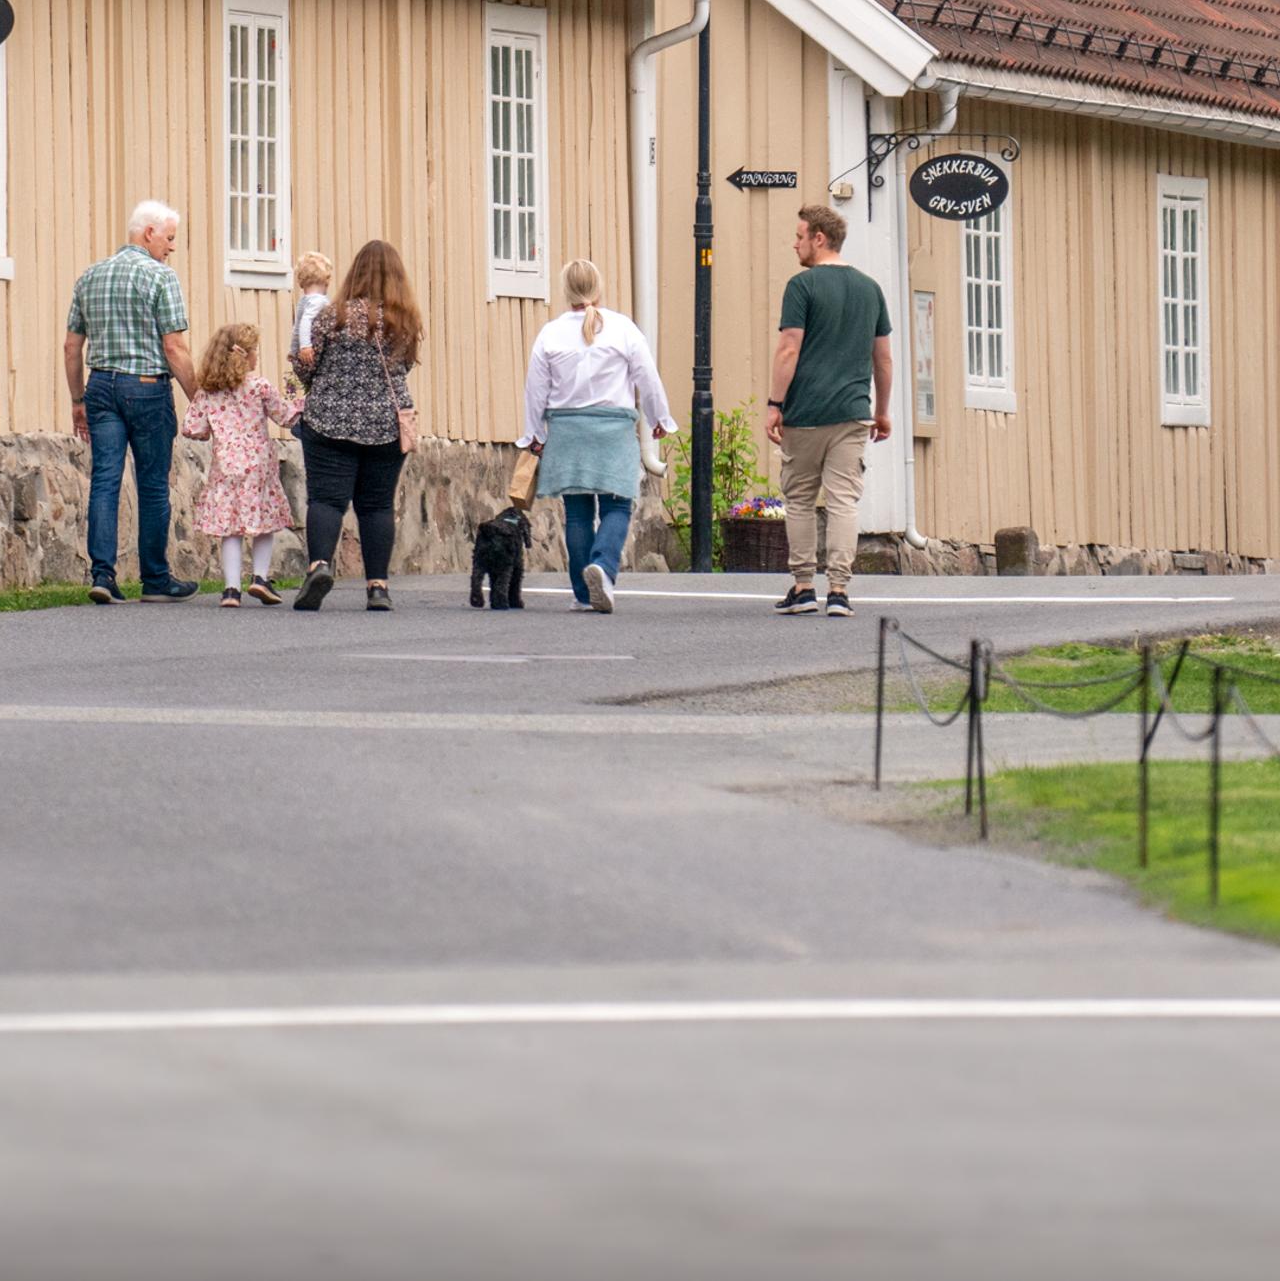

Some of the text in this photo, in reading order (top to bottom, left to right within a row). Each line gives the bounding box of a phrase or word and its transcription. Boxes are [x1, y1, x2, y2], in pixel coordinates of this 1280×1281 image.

[741, 172, 797, 186] INNGANG
[921, 159, 999, 186] SNEKKERBUA
[928, 192, 992, 215] GRY-SVEN
